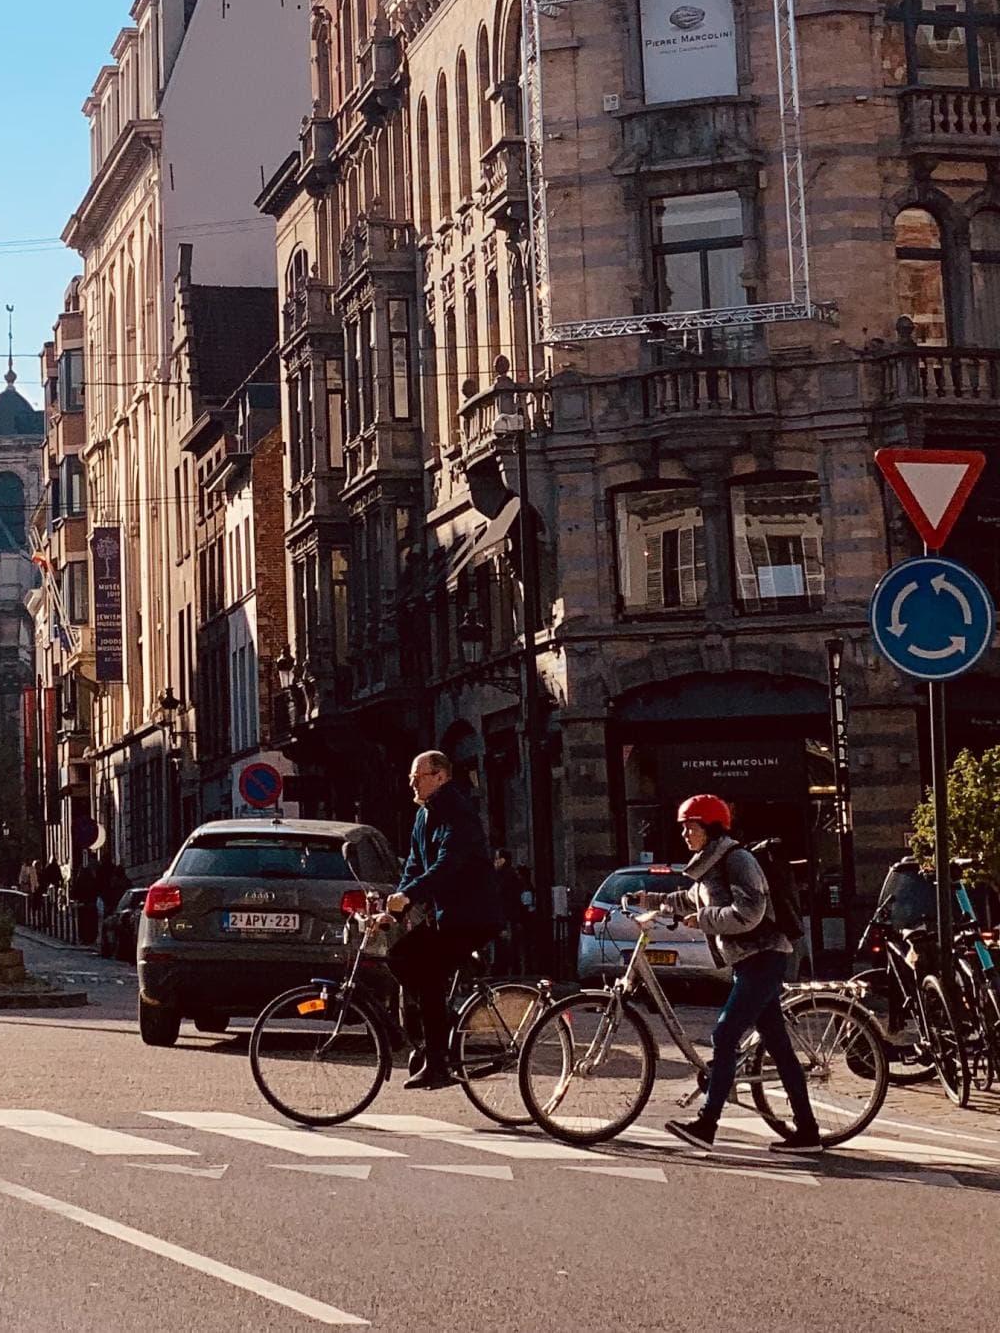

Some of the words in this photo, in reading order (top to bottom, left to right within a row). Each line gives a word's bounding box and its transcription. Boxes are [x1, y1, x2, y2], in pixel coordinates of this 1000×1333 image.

[645, 38, 677, 48] PIERRE
[680, 30, 732, 43] MARCOLINI
[682, 759, 719, 768] PIERRE
[722, 757, 779, 767] MARCOLINI
